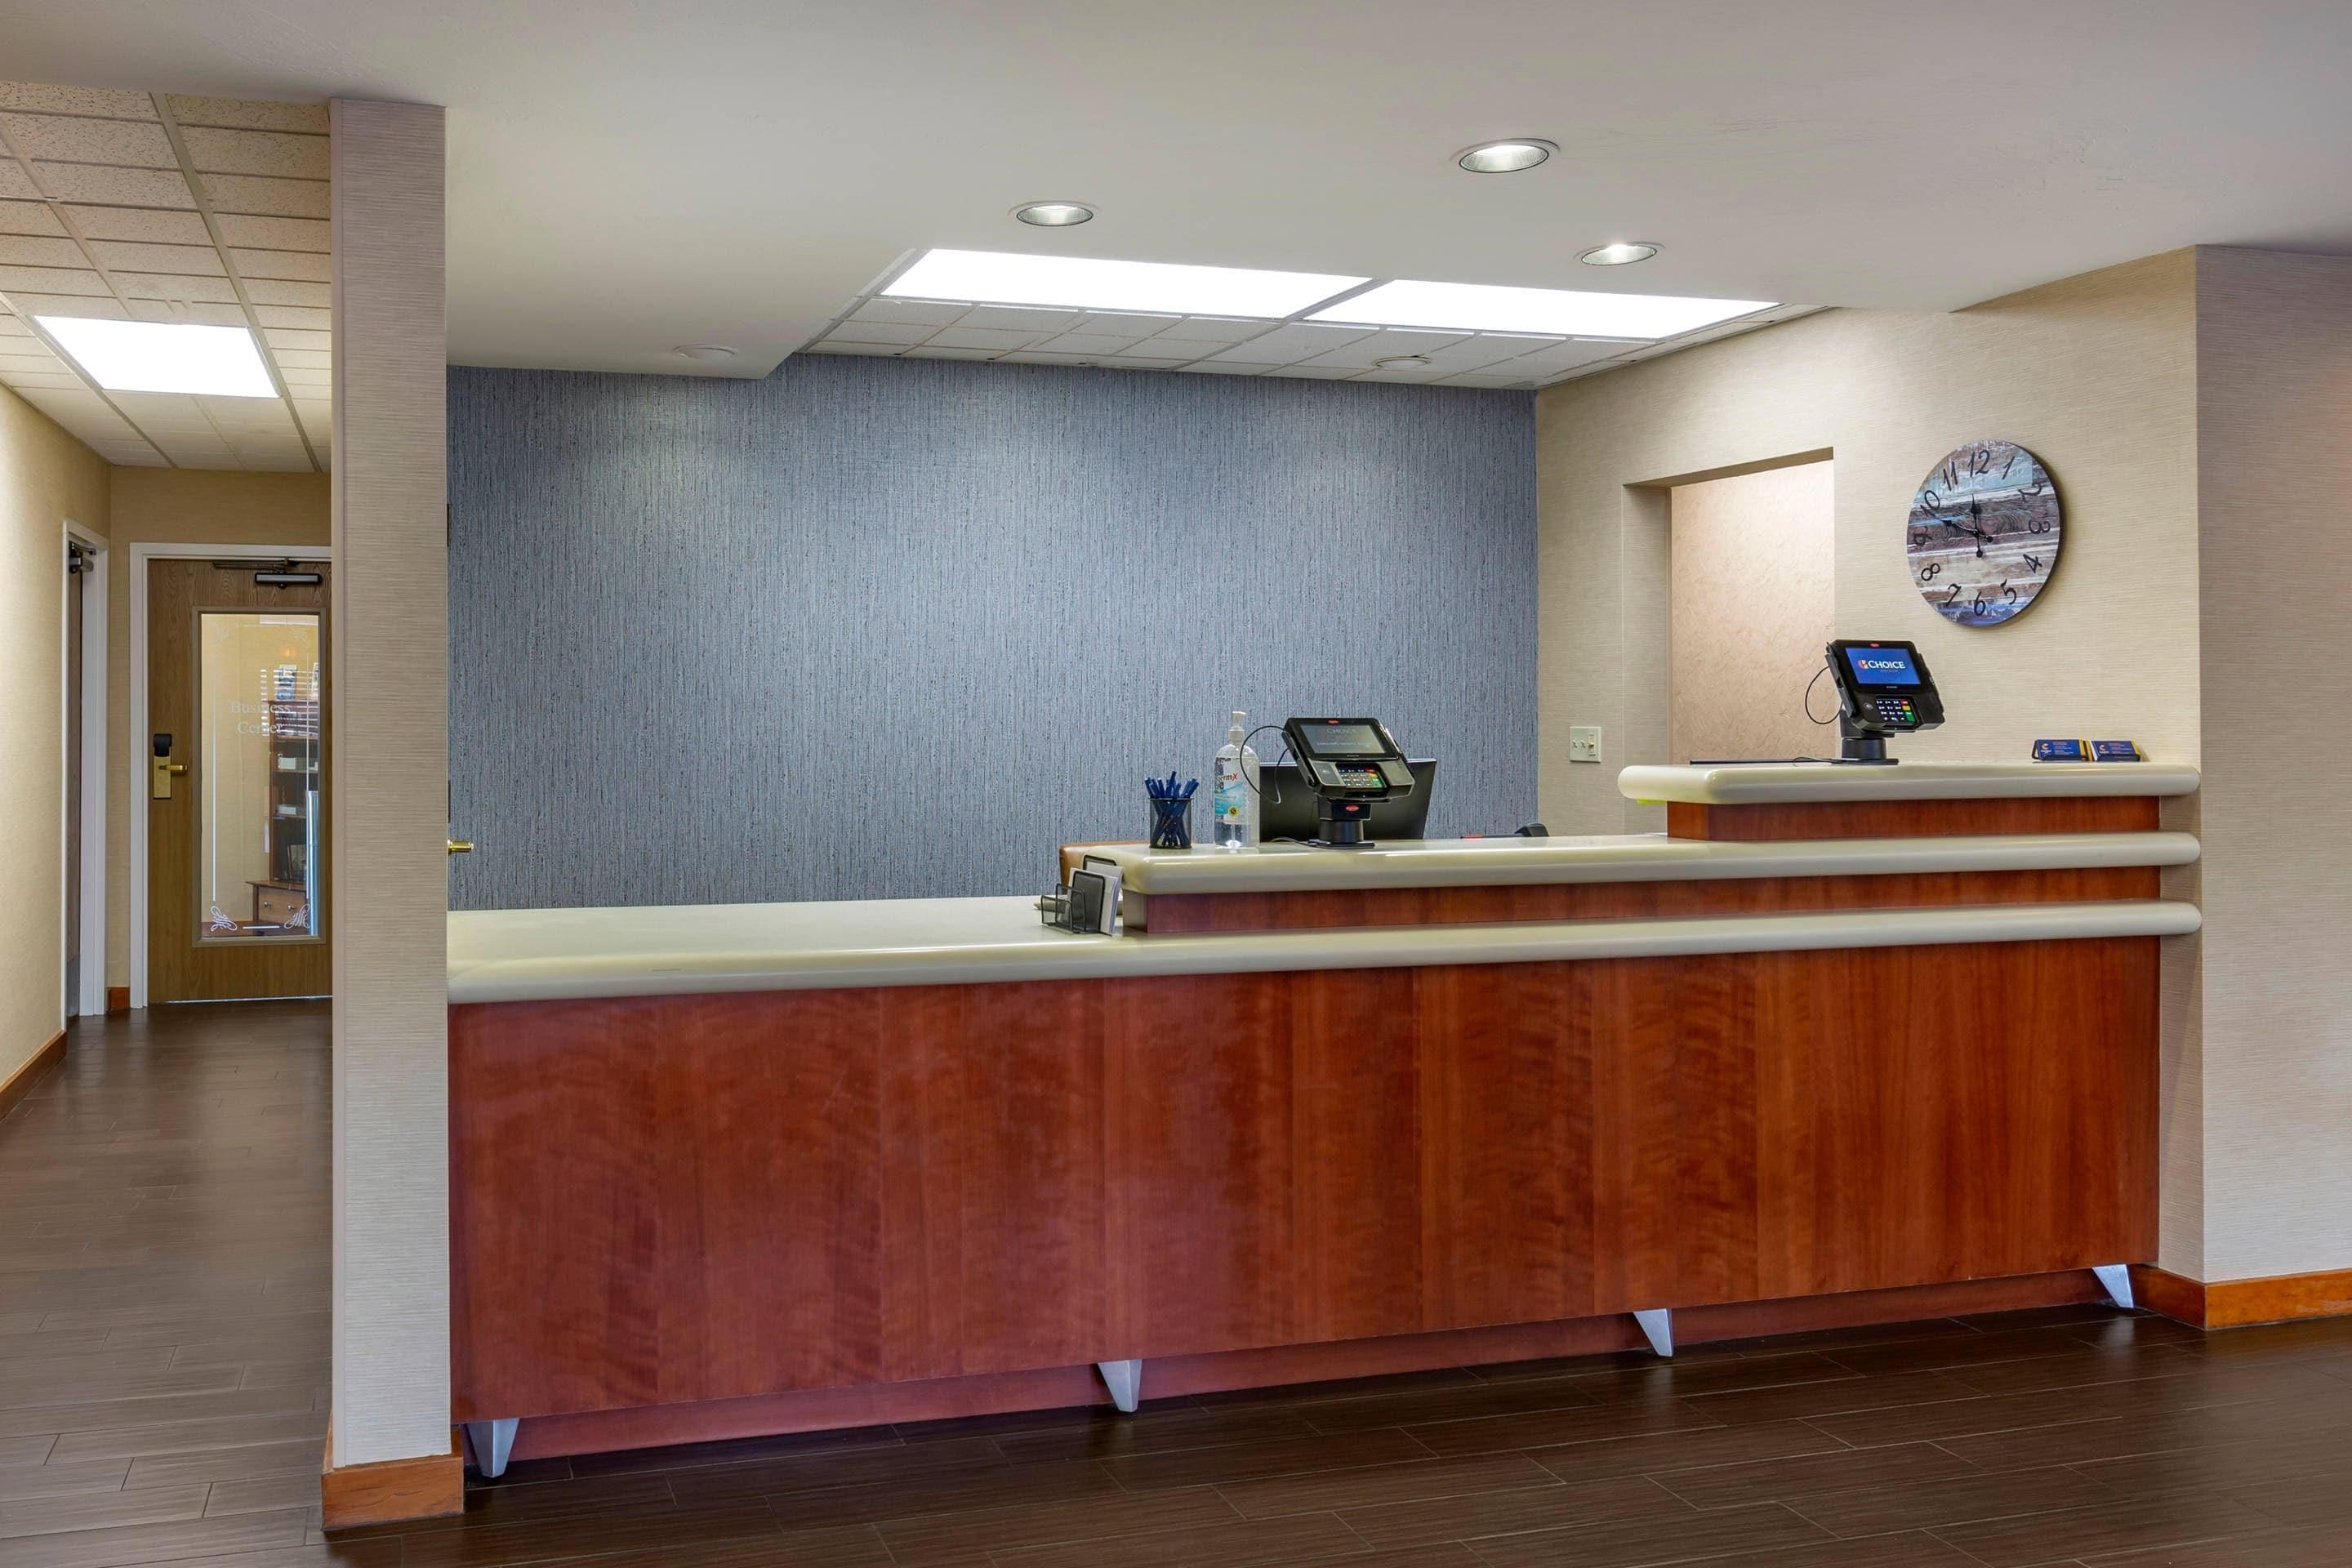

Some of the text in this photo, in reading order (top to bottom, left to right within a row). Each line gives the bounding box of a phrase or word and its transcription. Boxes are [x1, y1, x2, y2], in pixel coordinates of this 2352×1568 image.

[1967, 449, 1991, 478] 12
[2003, 456, 2016, 480] 1
[1943, 461, 1959, 492] 11
[1920, 490, 1940, 518] 10
[1921, 563, 1940, 581] 8
[2023, 554, 2042, 573] 4
[1945, 583, 1962, 607] 7
[1974, 591, 1986, 617] 6
[2000, 578, 2017, 605] 5
[1868, 660, 1906, 669] CHOICE
